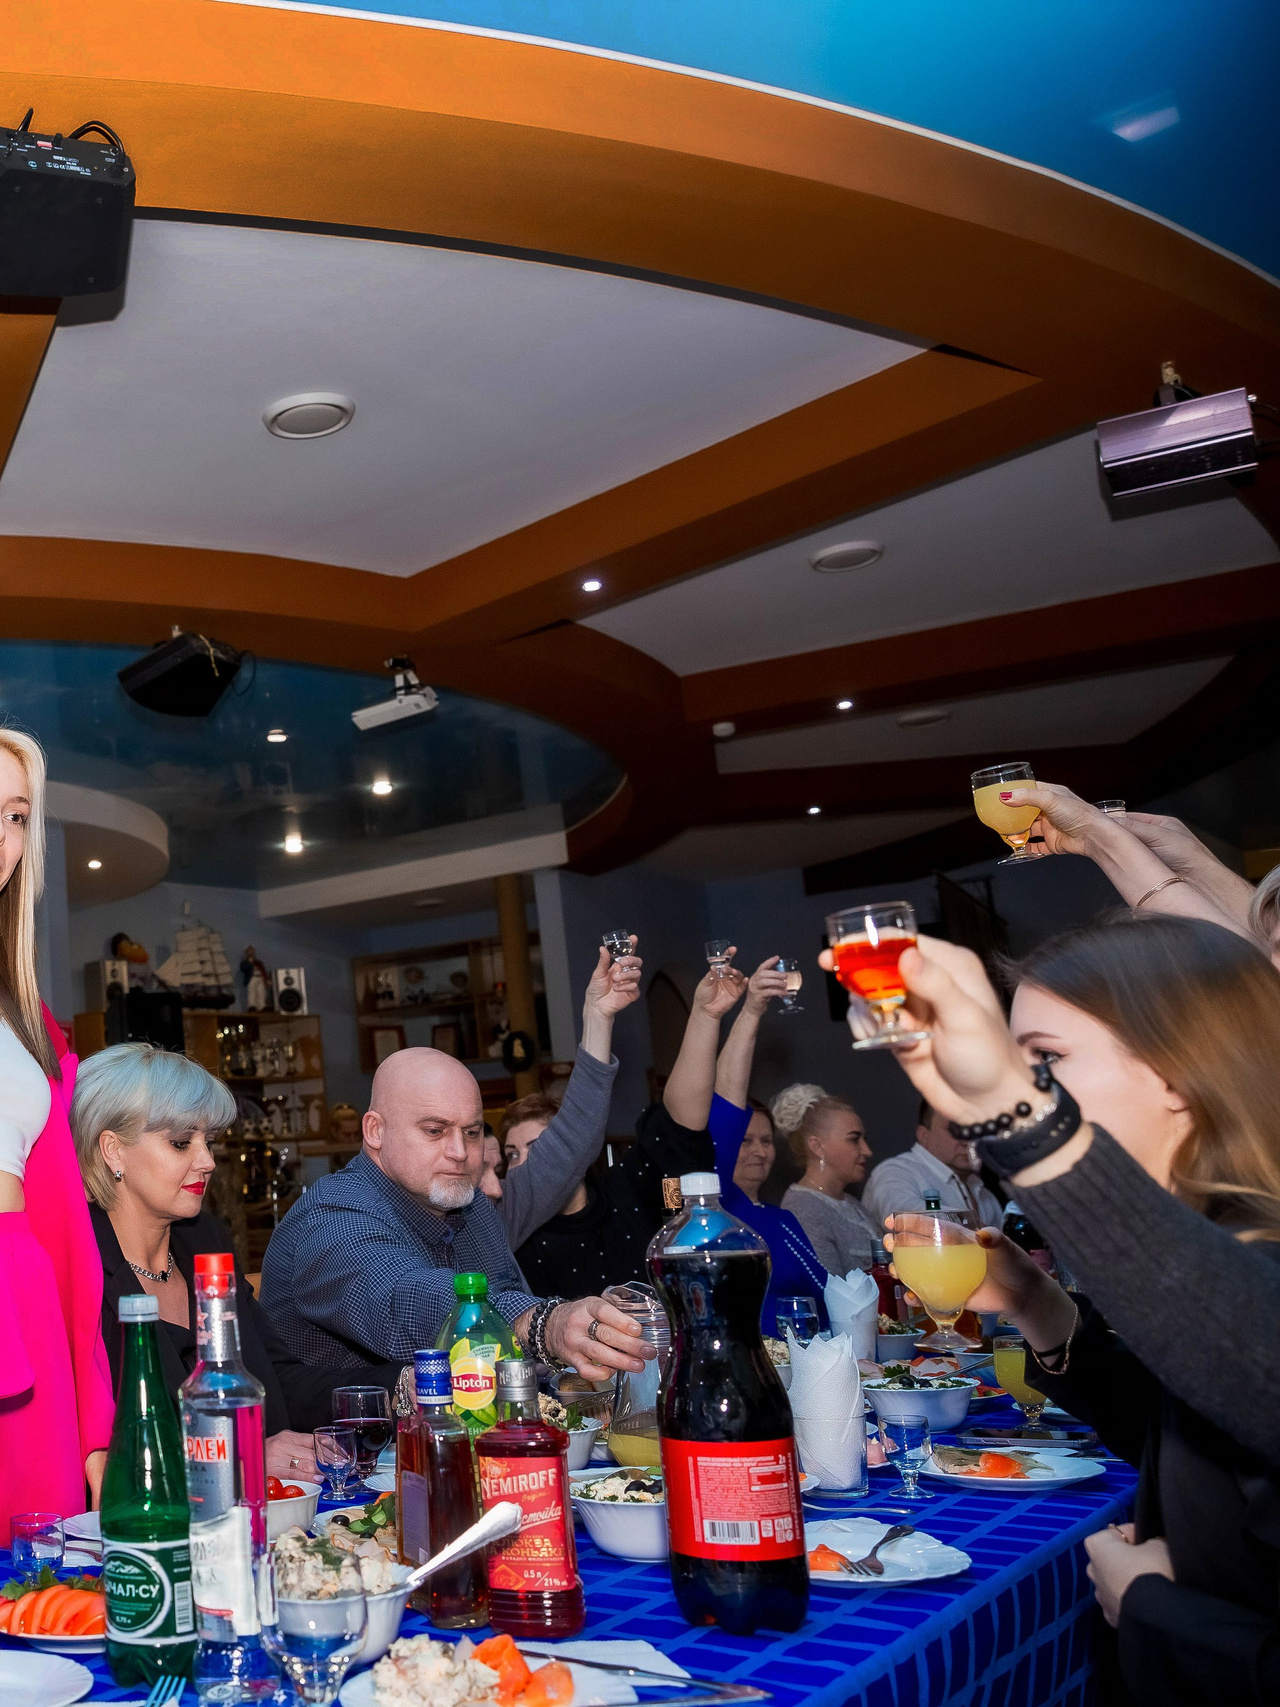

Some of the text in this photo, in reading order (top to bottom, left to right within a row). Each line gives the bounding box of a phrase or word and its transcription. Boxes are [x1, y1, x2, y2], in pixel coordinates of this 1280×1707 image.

[453, 1378, 490, 1390] Lipton
[187, 1433, 228, 1462] РЛЕЙ
[481, 1468, 557, 1500] NEMIROFF
[521, 1500, 562, 1525] стойка
